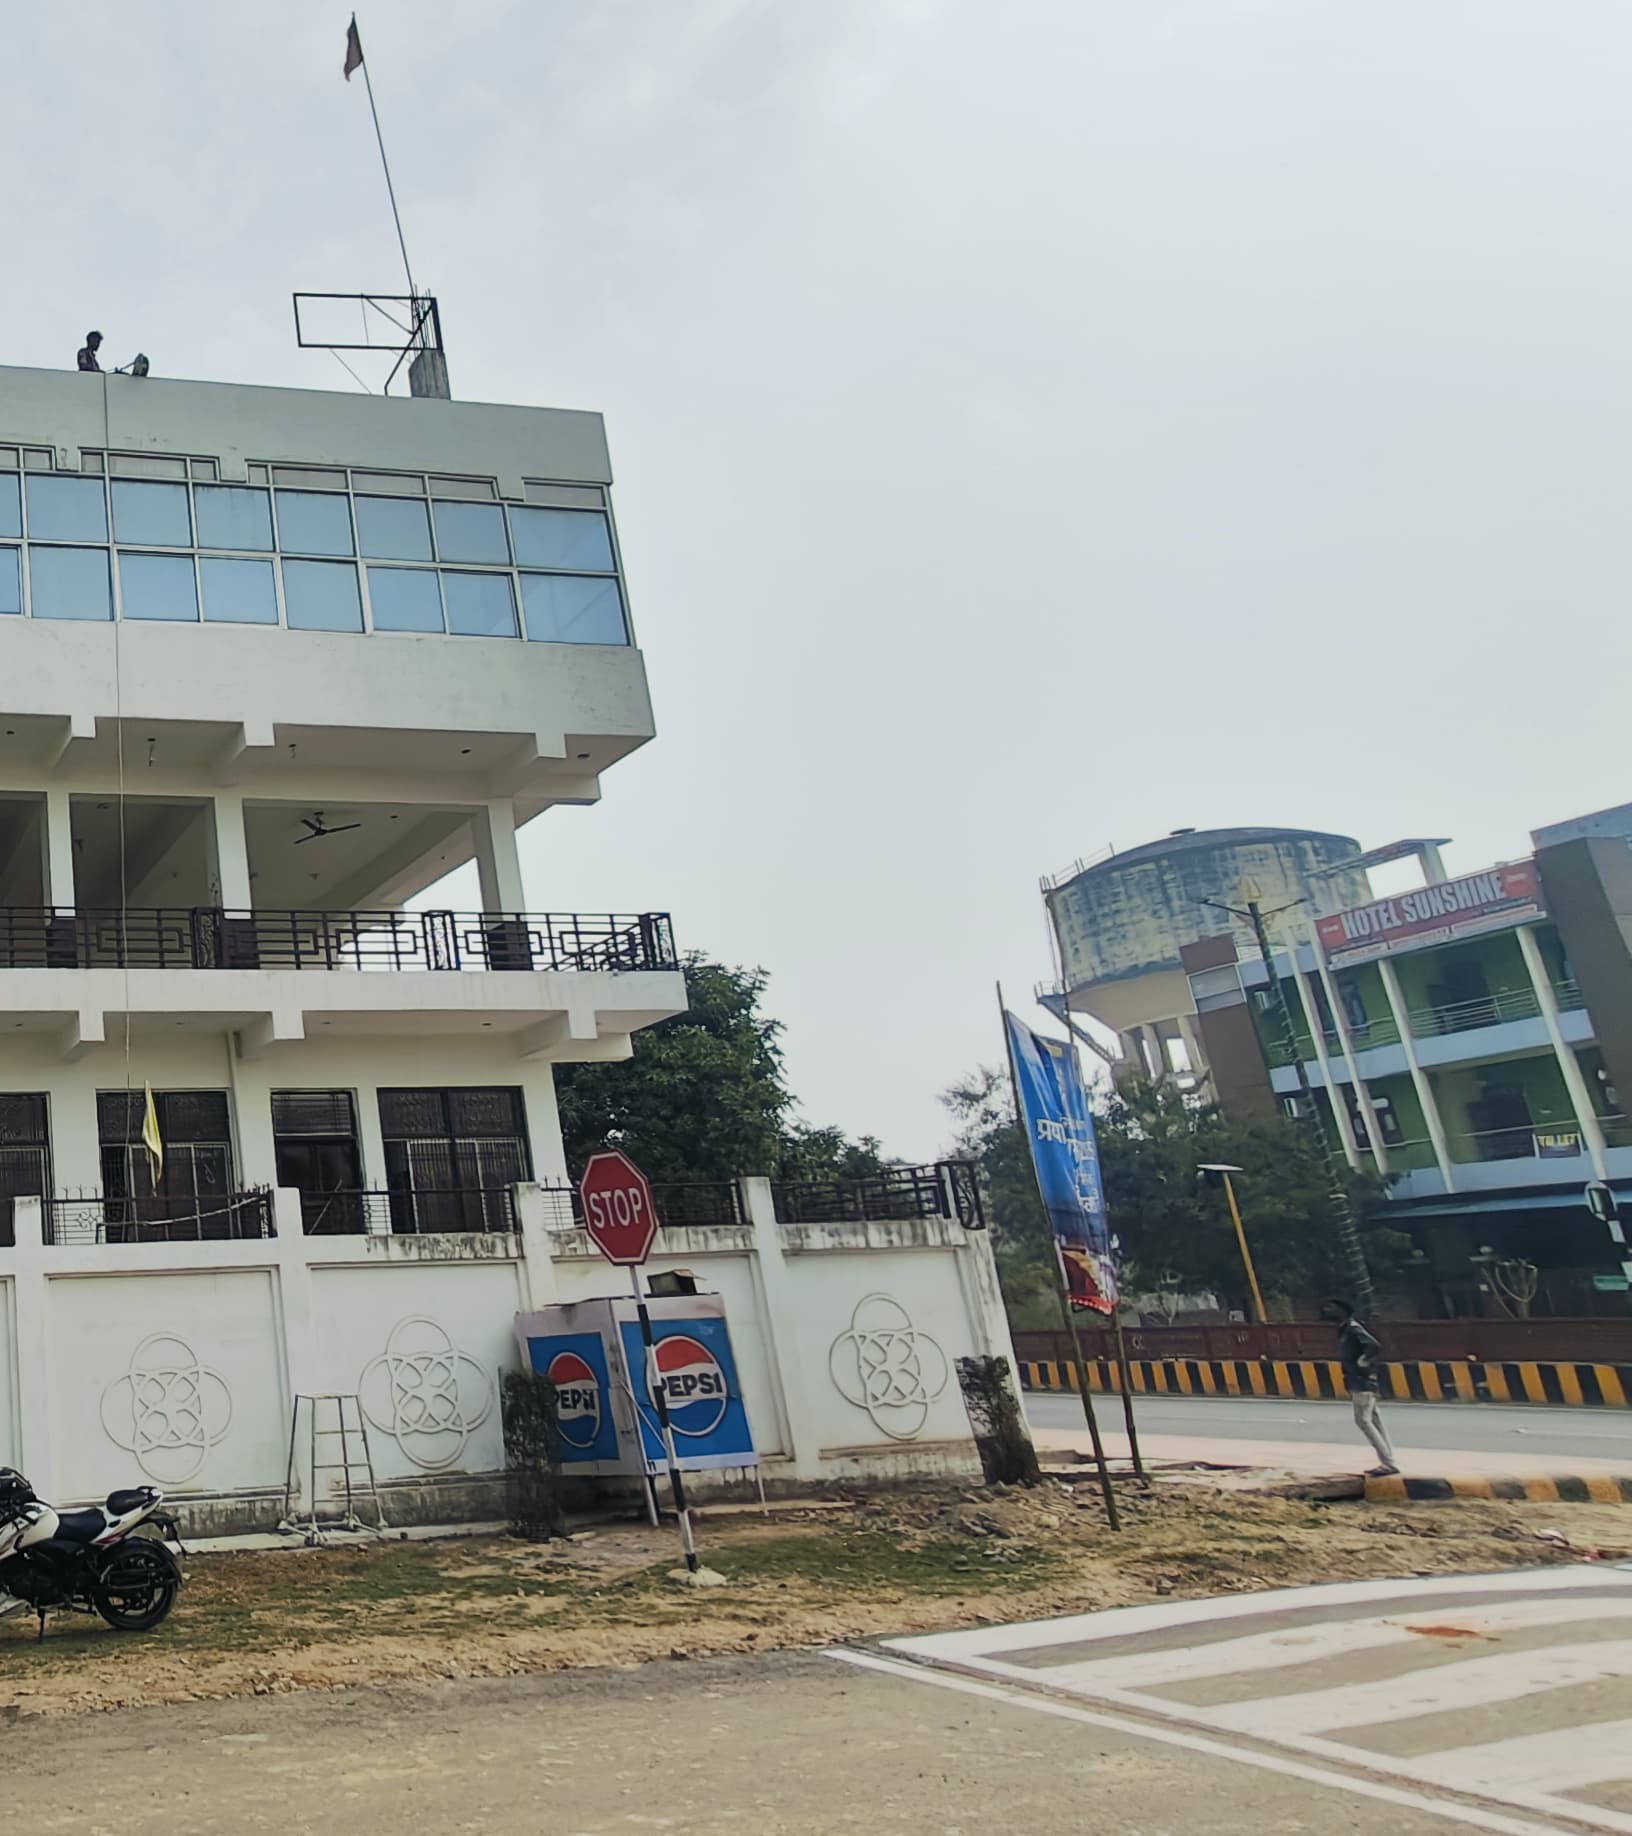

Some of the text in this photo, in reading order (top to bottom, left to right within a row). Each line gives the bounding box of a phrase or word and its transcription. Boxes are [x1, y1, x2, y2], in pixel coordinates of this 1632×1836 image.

[1341, 900, 1403, 939] HOTEL
[1402, 872, 1507, 923] SUNSHINE
[589, 1187, 642, 1229] STOP
